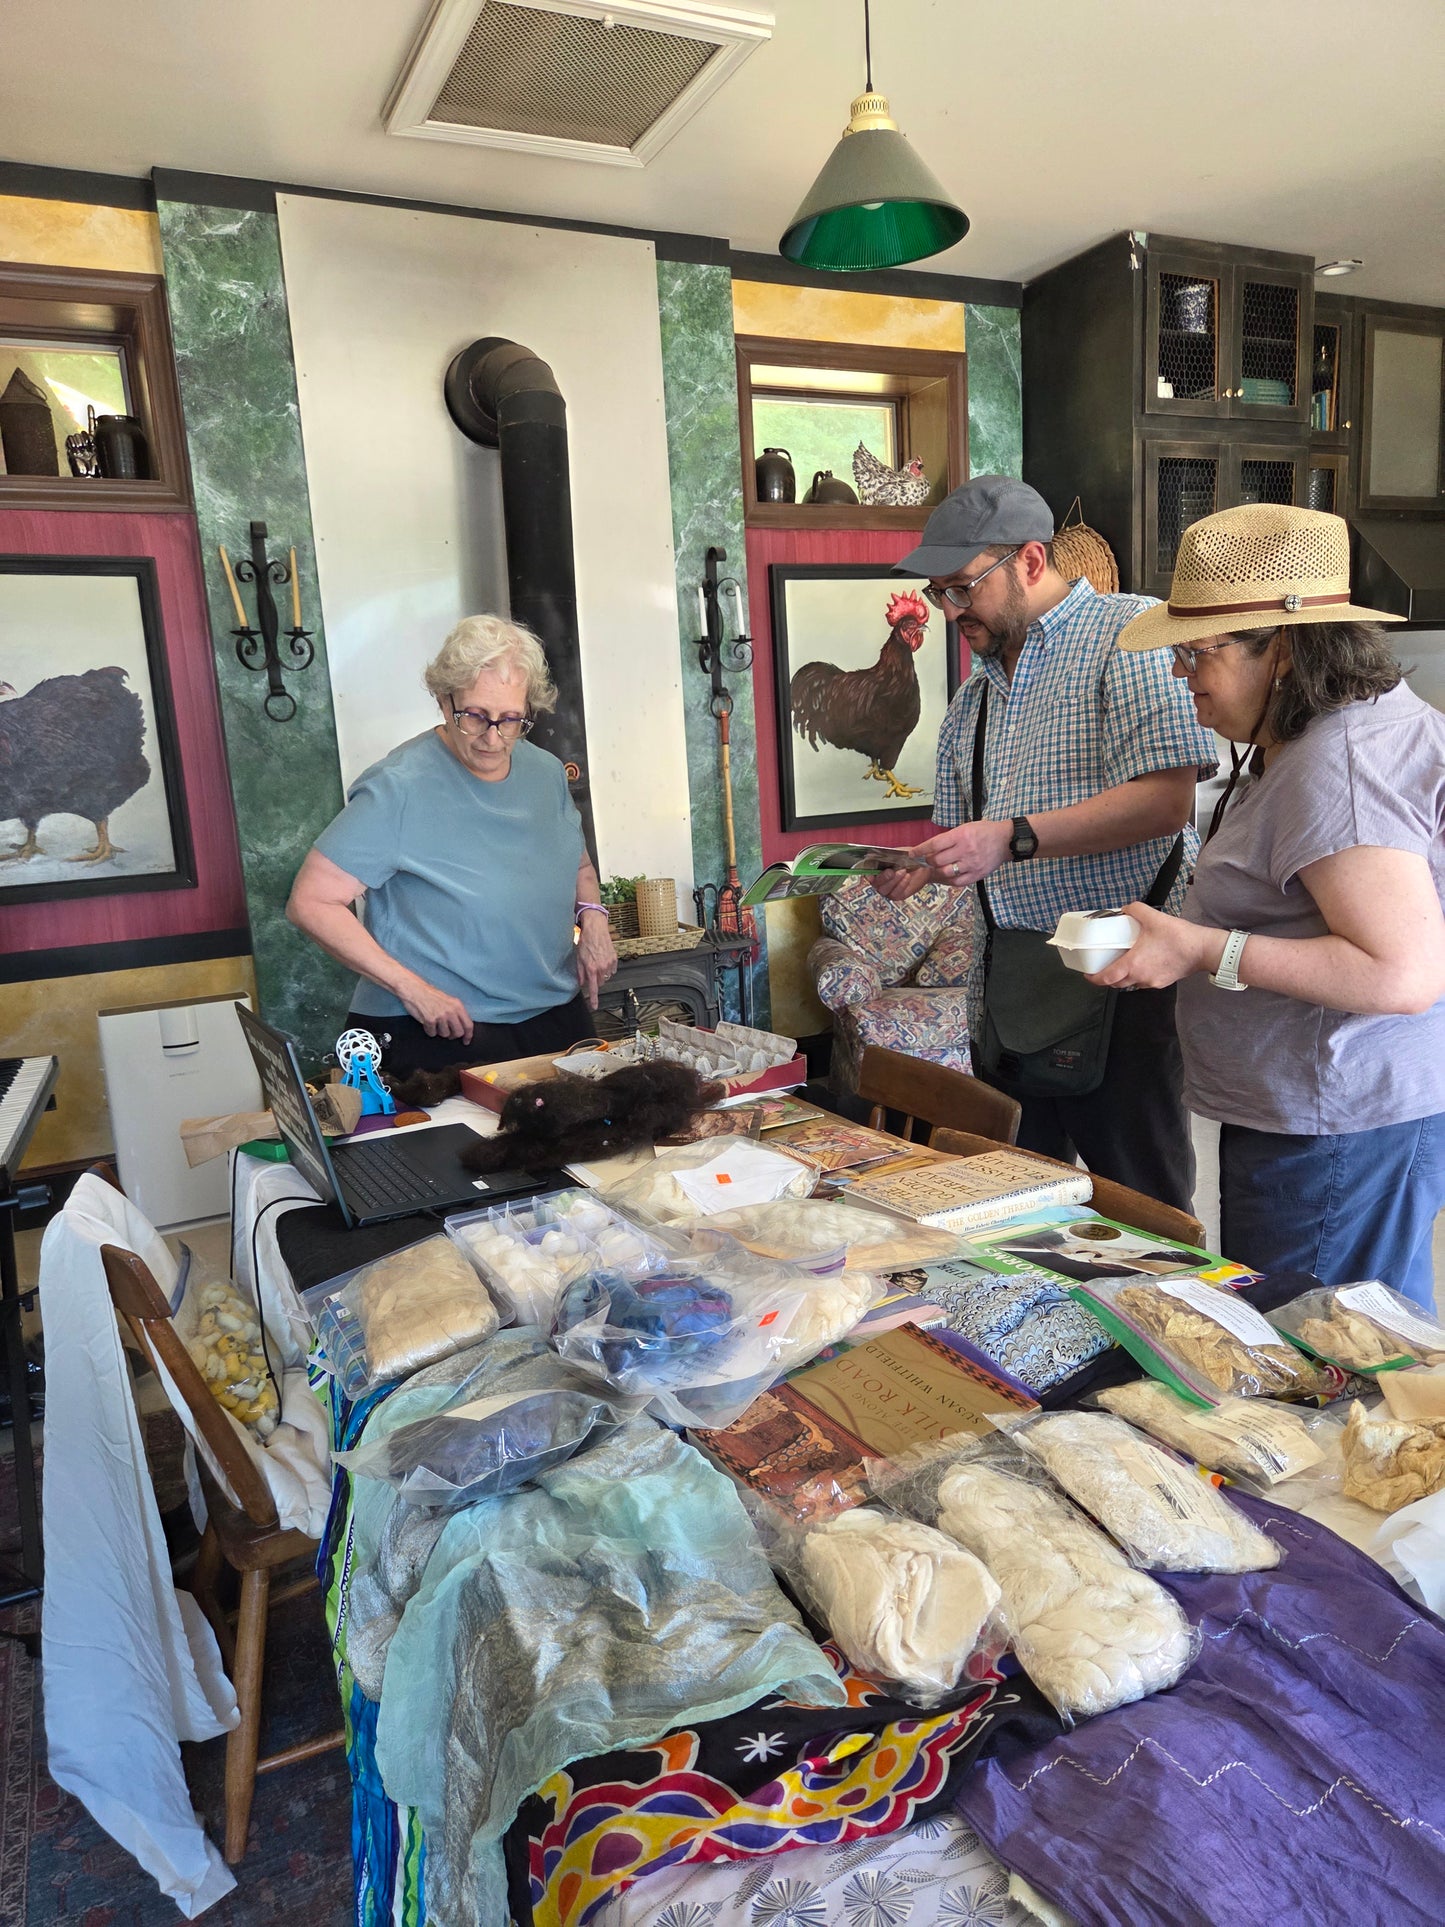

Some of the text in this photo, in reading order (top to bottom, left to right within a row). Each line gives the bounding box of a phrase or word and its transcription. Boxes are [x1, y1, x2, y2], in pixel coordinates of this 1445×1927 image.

[915, 1171, 981, 1198] THREAD
[964, 1161, 1022, 1182] KASSIA
[884, 1186, 921, 1201] THE
[893, 1176, 955, 1200] GOLDEN
[947, 1217, 964, 1229] THE
[967, 1209, 1000, 1223] GOLDEN
[1002, 1200, 1036, 1215] THREAD
[984, 1247, 1081, 1291] ILKWORMS
[836, 1359, 898, 1403] ROAD
[865, 1345, 983, 1425] SUSAN WHITFIELD
[828, 1375, 919, 1440] LIFE ALONG THE
